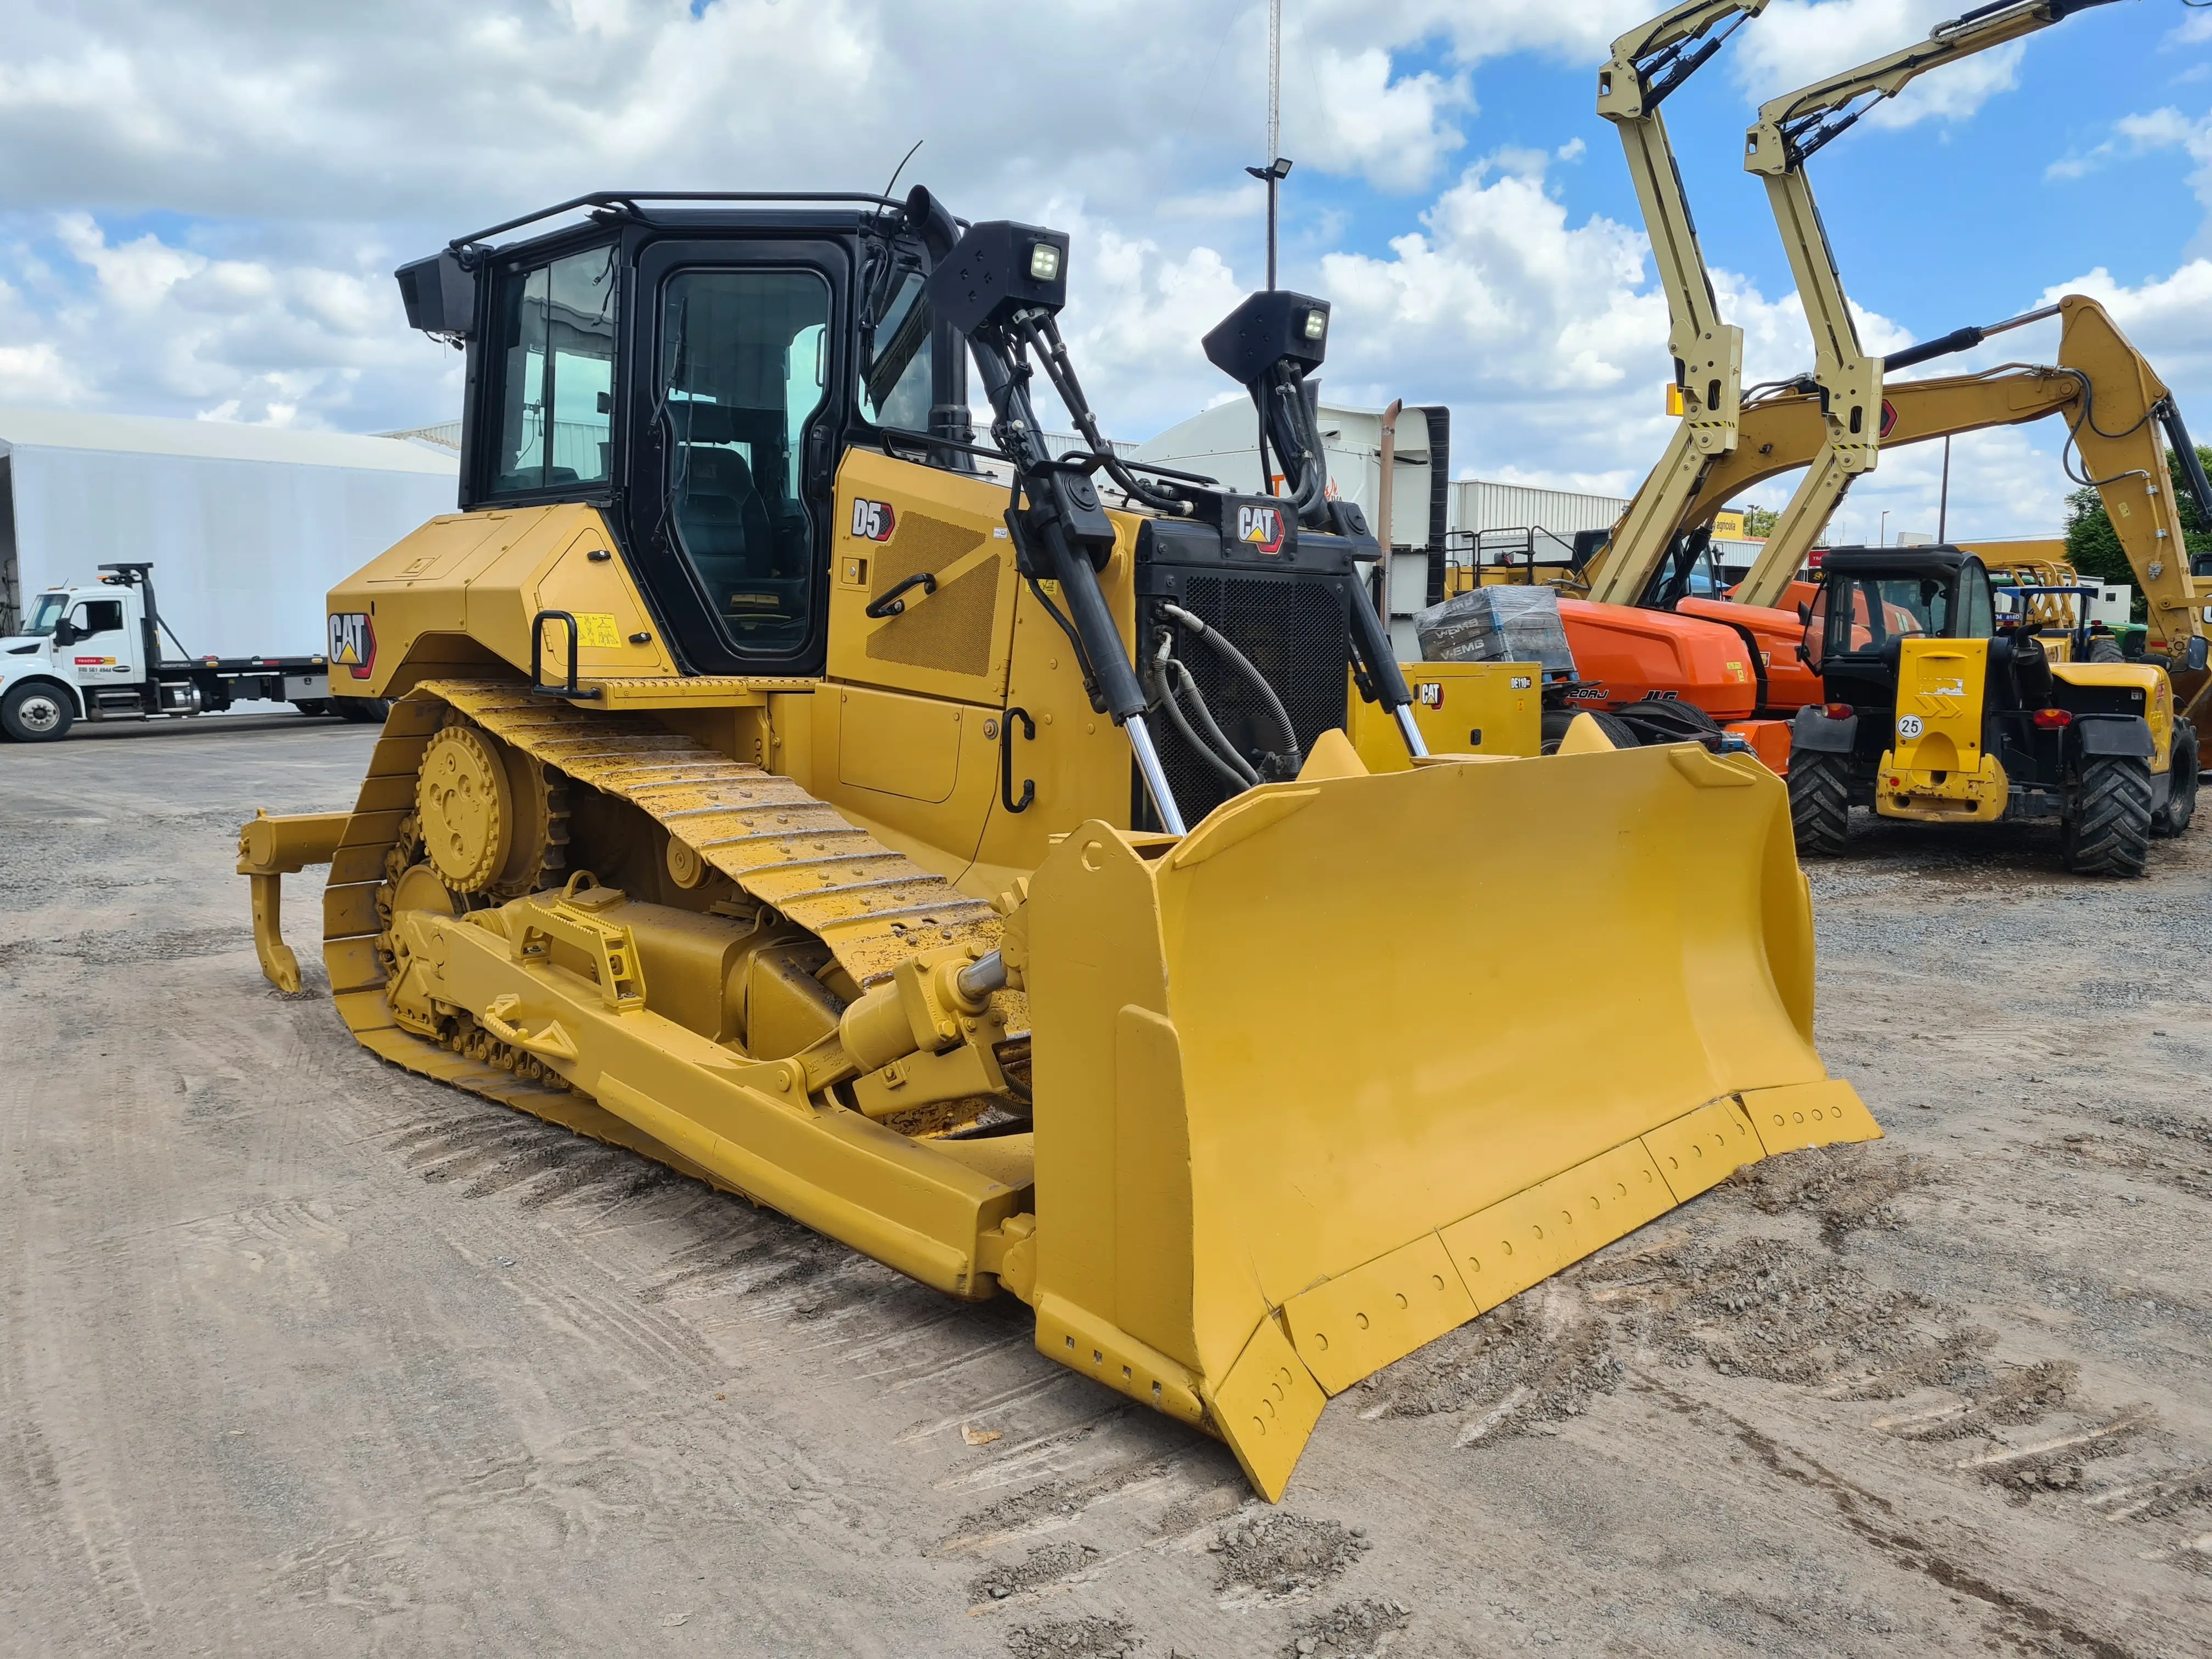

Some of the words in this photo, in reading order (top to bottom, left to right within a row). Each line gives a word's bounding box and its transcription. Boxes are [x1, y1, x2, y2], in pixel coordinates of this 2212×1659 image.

[852, 499, 881, 538] D5
[1238, 507, 1274, 543] CAT
[1716, 519, 1736, 532] agrícola
[329, 614, 365, 663] CAT
[1440, 639, 1485, 660] V-EMB
[1422, 684, 1440, 704] CAT
[1566, 689, 1609, 699] 20AJ
[1901, 720, 1919, 733] 25
